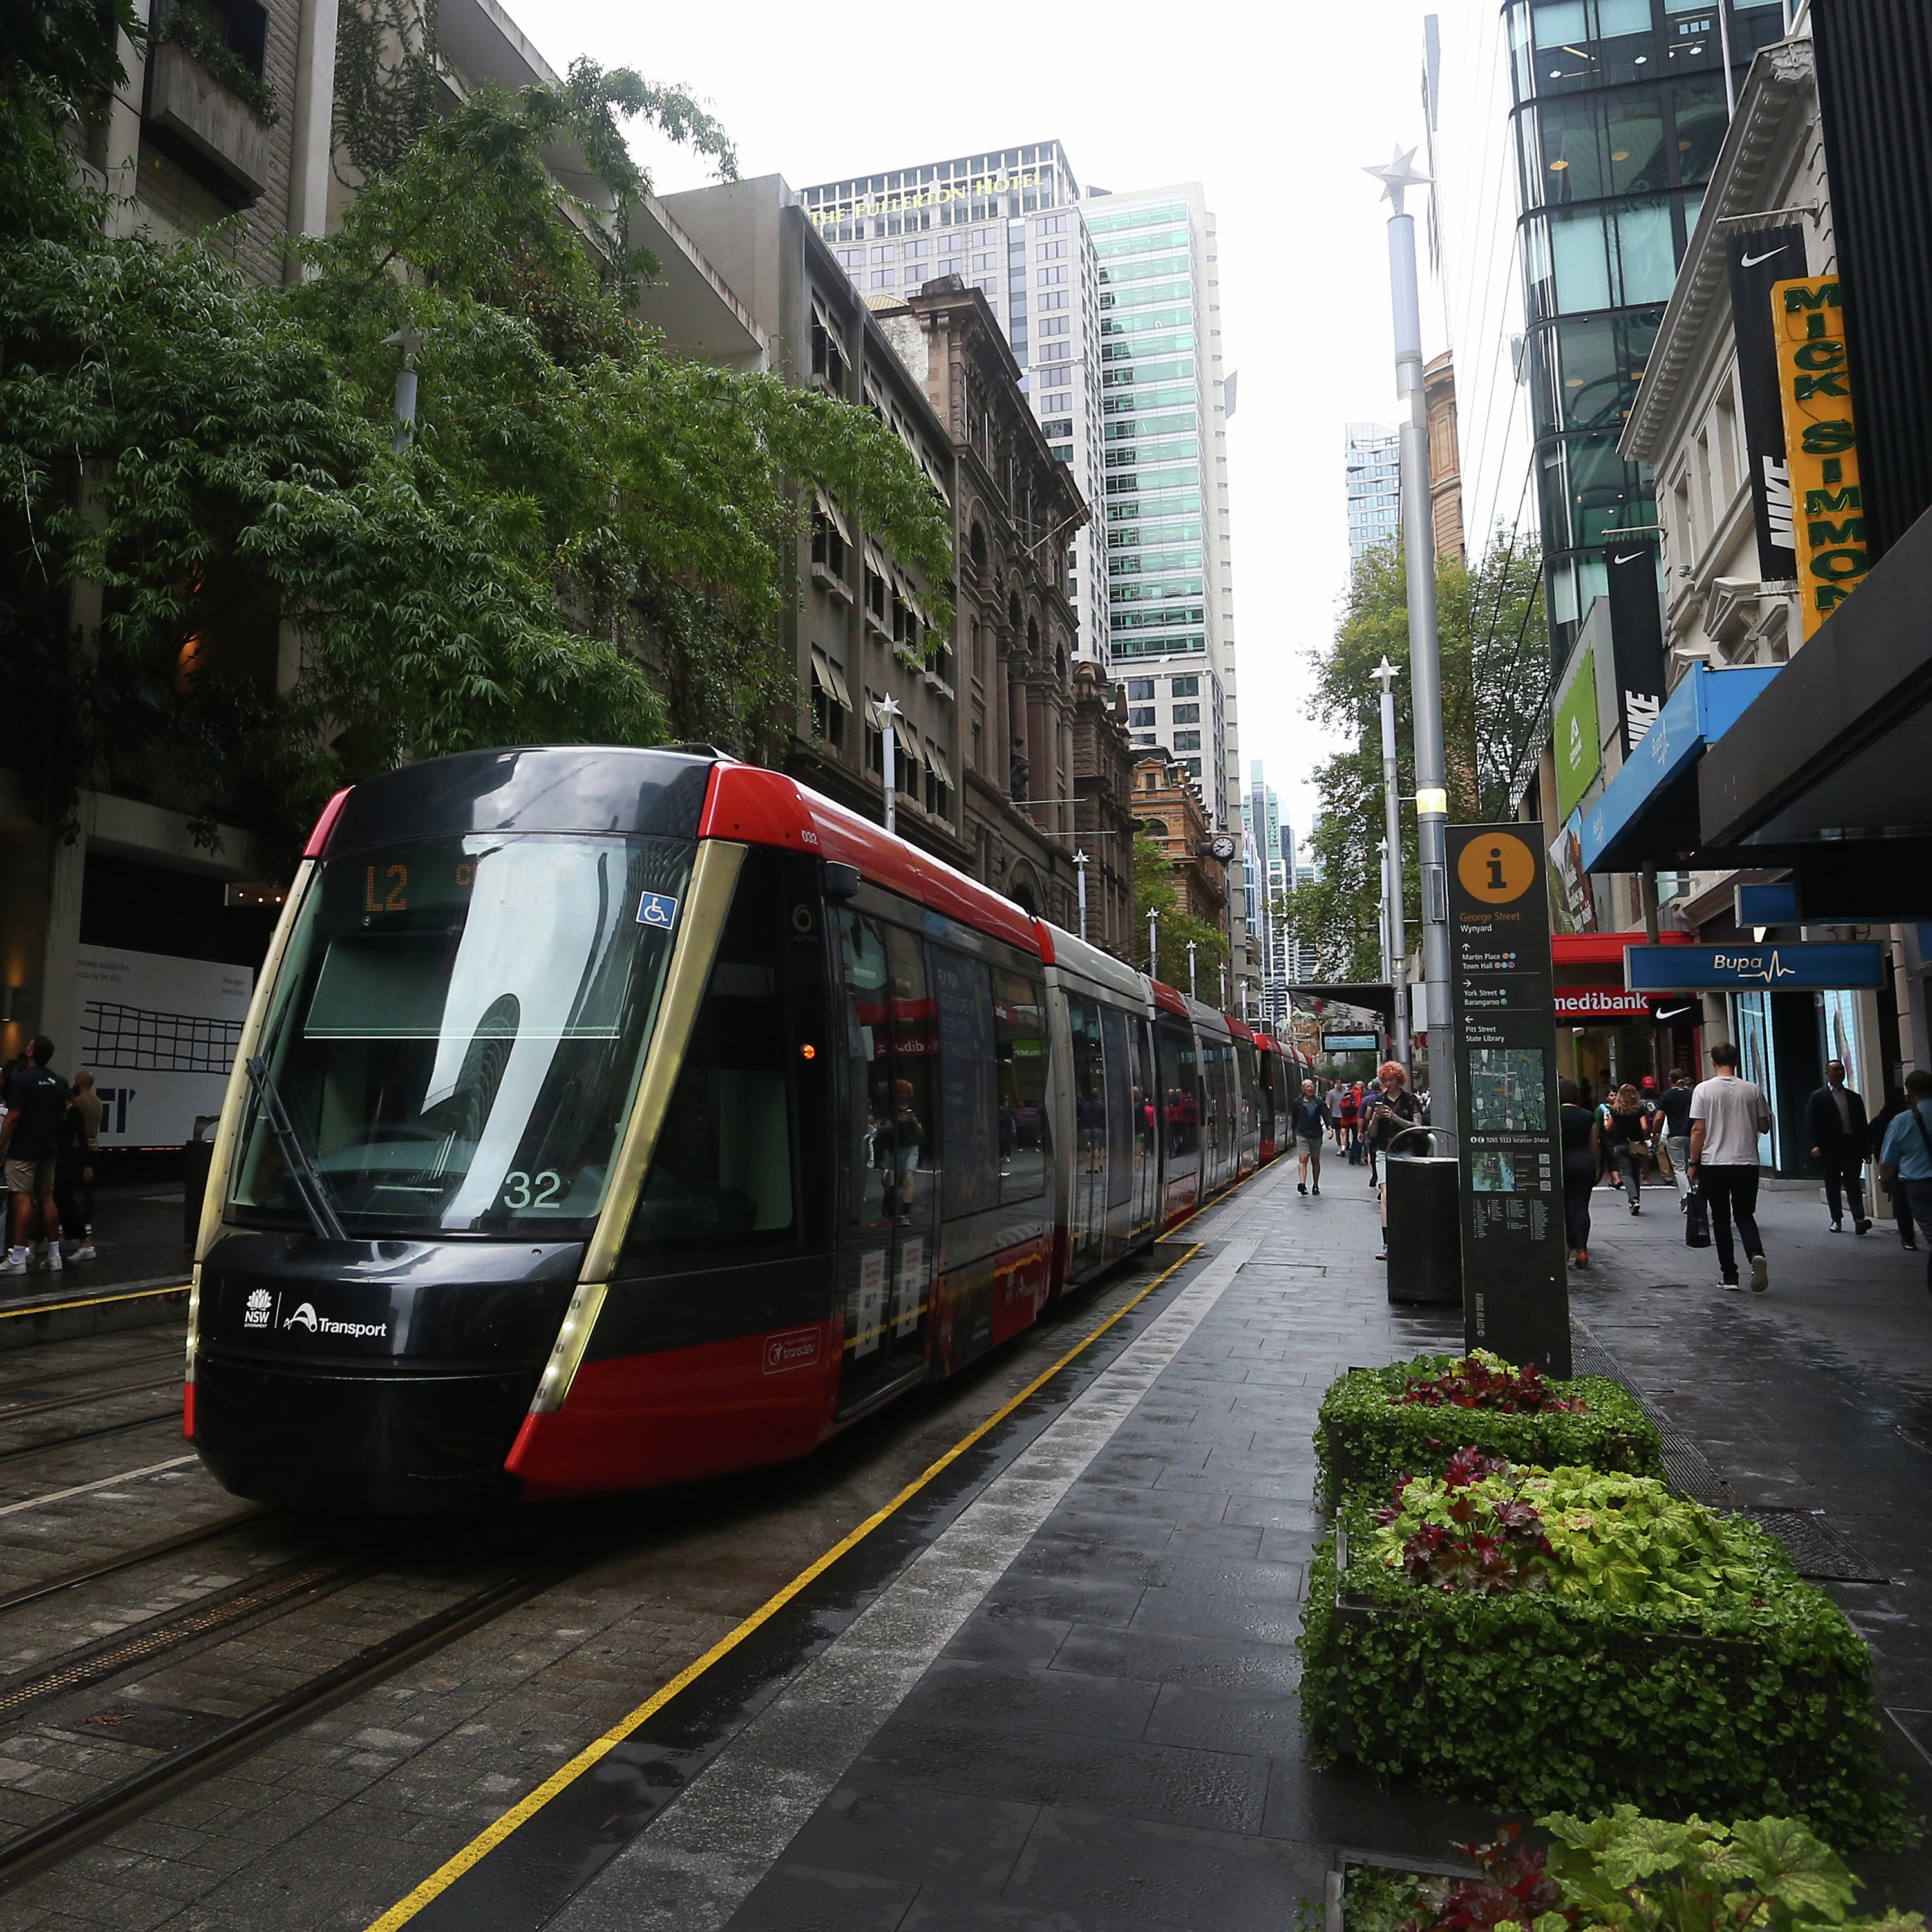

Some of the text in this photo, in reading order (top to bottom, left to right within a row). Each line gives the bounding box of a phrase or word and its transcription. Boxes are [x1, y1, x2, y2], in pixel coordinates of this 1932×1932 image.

[811, 172, 1043, 227] THE FULLERTON HOTEL
[1784, 282, 1851, 399] MICK
[801, 830, 819, 845] 032
[366, 865, 407, 911] L2
[1460, 912, 1520, 923] George Street
[1460, 924, 1492, 934] Wynyard
[1714, 954, 1762, 972] Bupa
[1554, 992, 1649, 1010] medibank
[503, 1171, 560, 1209] 32
[245, 1311, 270, 1323] NSW
[318, 1318, 388, 1338] Transport
[783, 1343, 815, 1359] transdev
